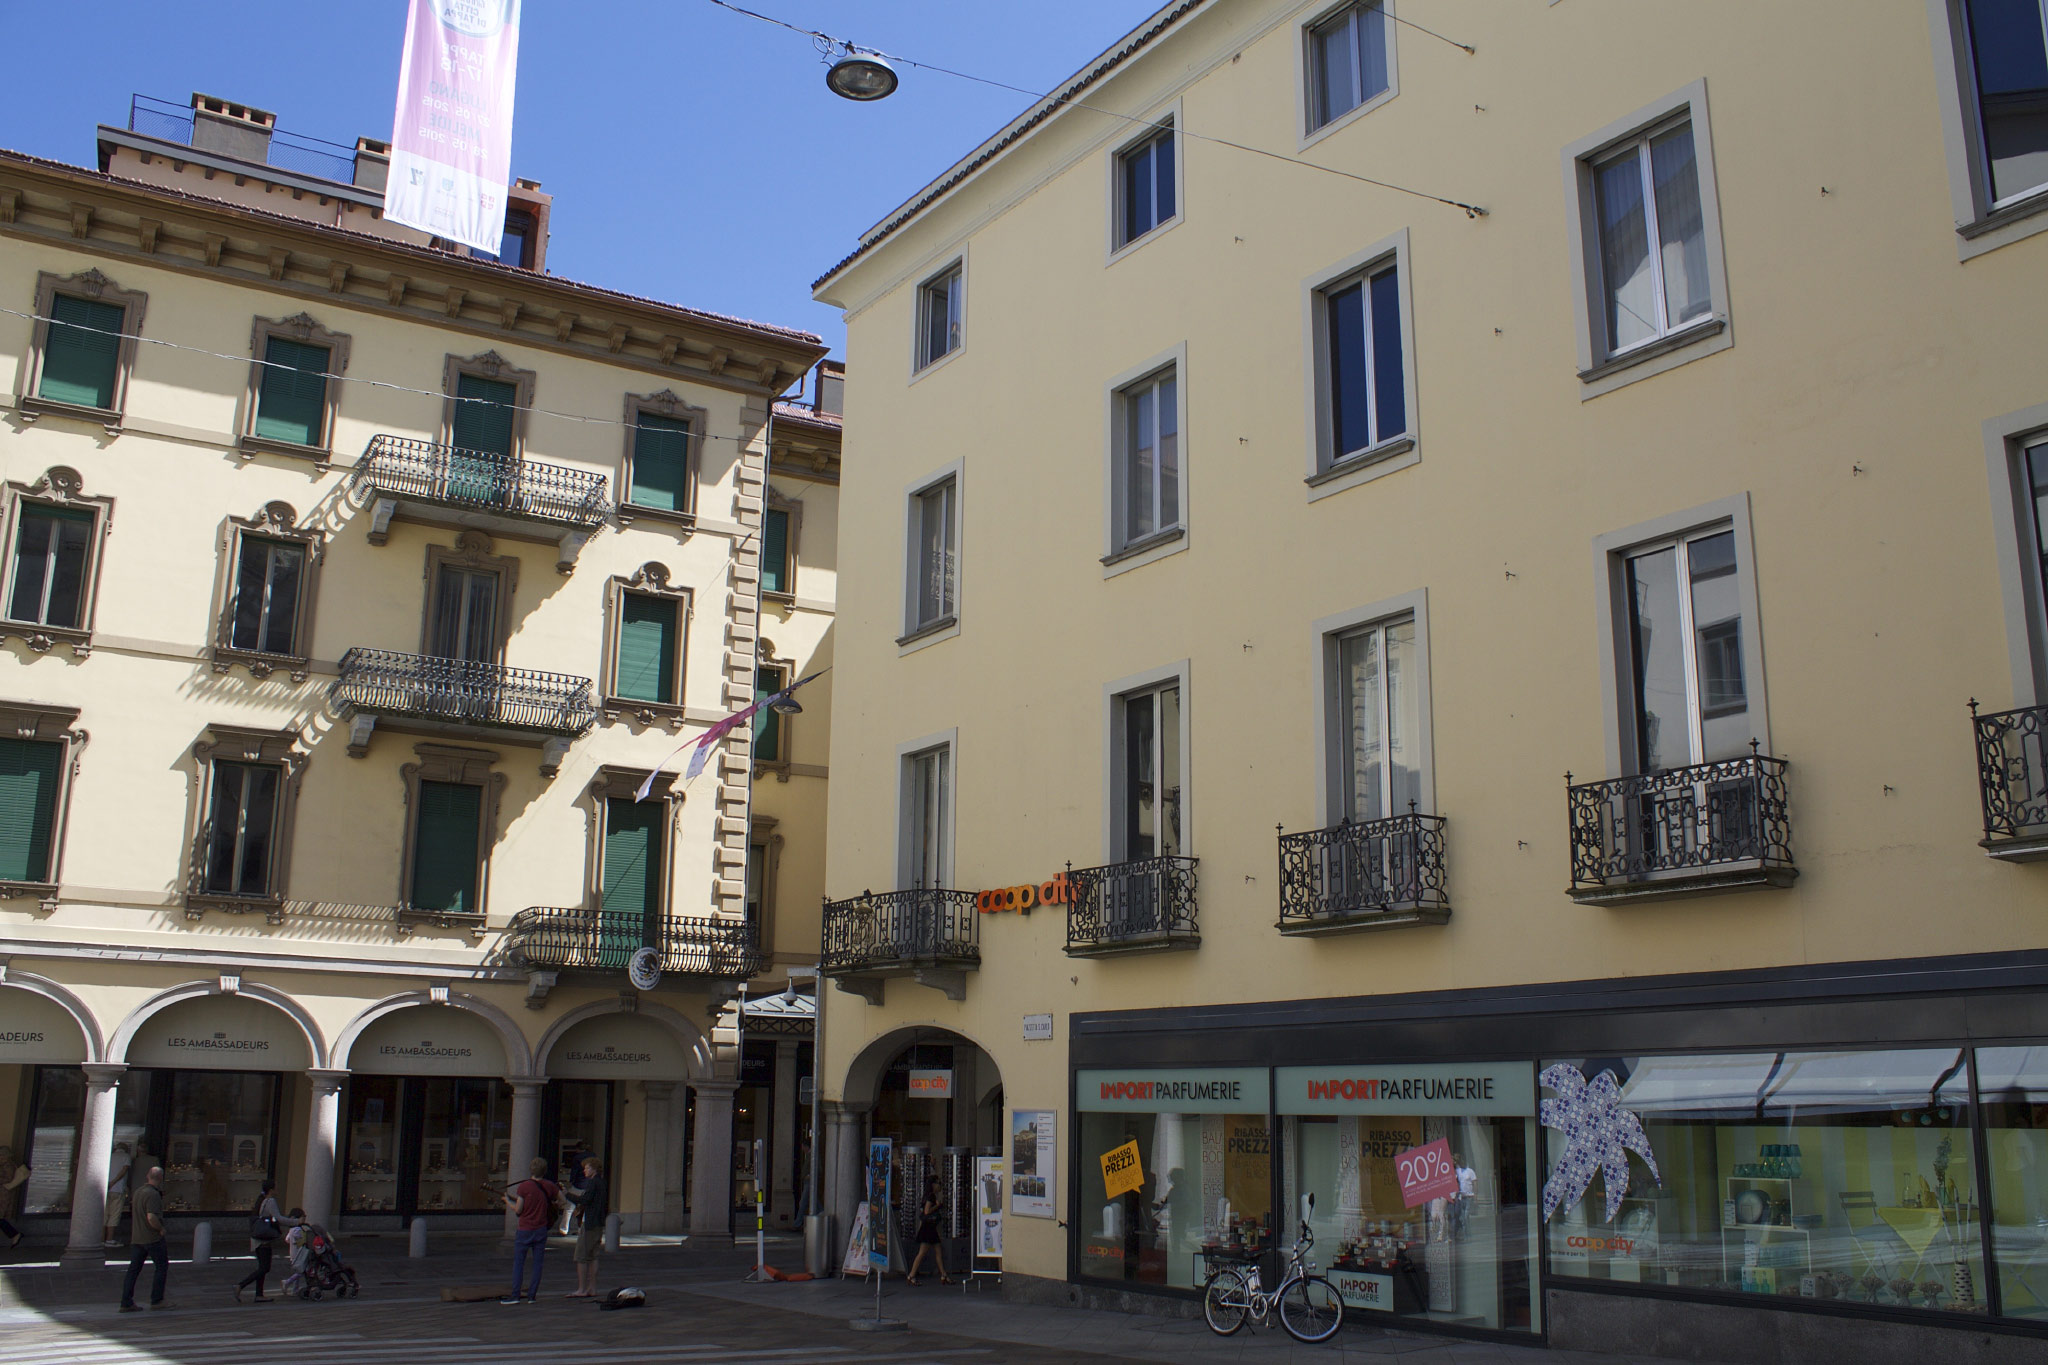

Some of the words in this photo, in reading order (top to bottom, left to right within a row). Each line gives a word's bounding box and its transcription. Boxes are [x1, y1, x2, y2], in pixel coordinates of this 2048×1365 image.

[977, 884, 1036, 915] coop
[168, 1038, 186, 1047] LES
[188, 1038, 269, 1050] AMBASSADEURS
[380, 1046, 396, 1055] LES
[398, 1046, 472, 1057] AMBASSADEURS
[567, 1052, 582, 1061] LES
[583, 1052, 651, 1062] AMBASSADEURS
[910, 1078, 931, 1091] coop
[931, 1076, 948, 1092] city
[1100, 1081, 1155, 1100] IMPORT
[1156, 1081, 1241, 1100] PARFUMERIE
[1307, 1079, 1379, 1100] IMPORT
[1380, 1077, 1493, 1100] PARFUMERIE
[1369, 1130, 1412, 1142] RIBASSO
[1228, 1137, 1270, 1154] PREZZ
[1361, 1141, 1414, 1158] PREZZ
[1107, 1147, 1132, 1162] RIBASSO
[1105, 1153, 1136, 1176] PREZZI
[1400, 1147, 1450, 1189] 20%
[1567, 1235, 1606, 1252] coop
[1606, 1234, 1634, 1255] city
[1339, 1278, 1380, 1294] IMPORT
[1340, 1290, 1380, 1303] PARFUMERIE
